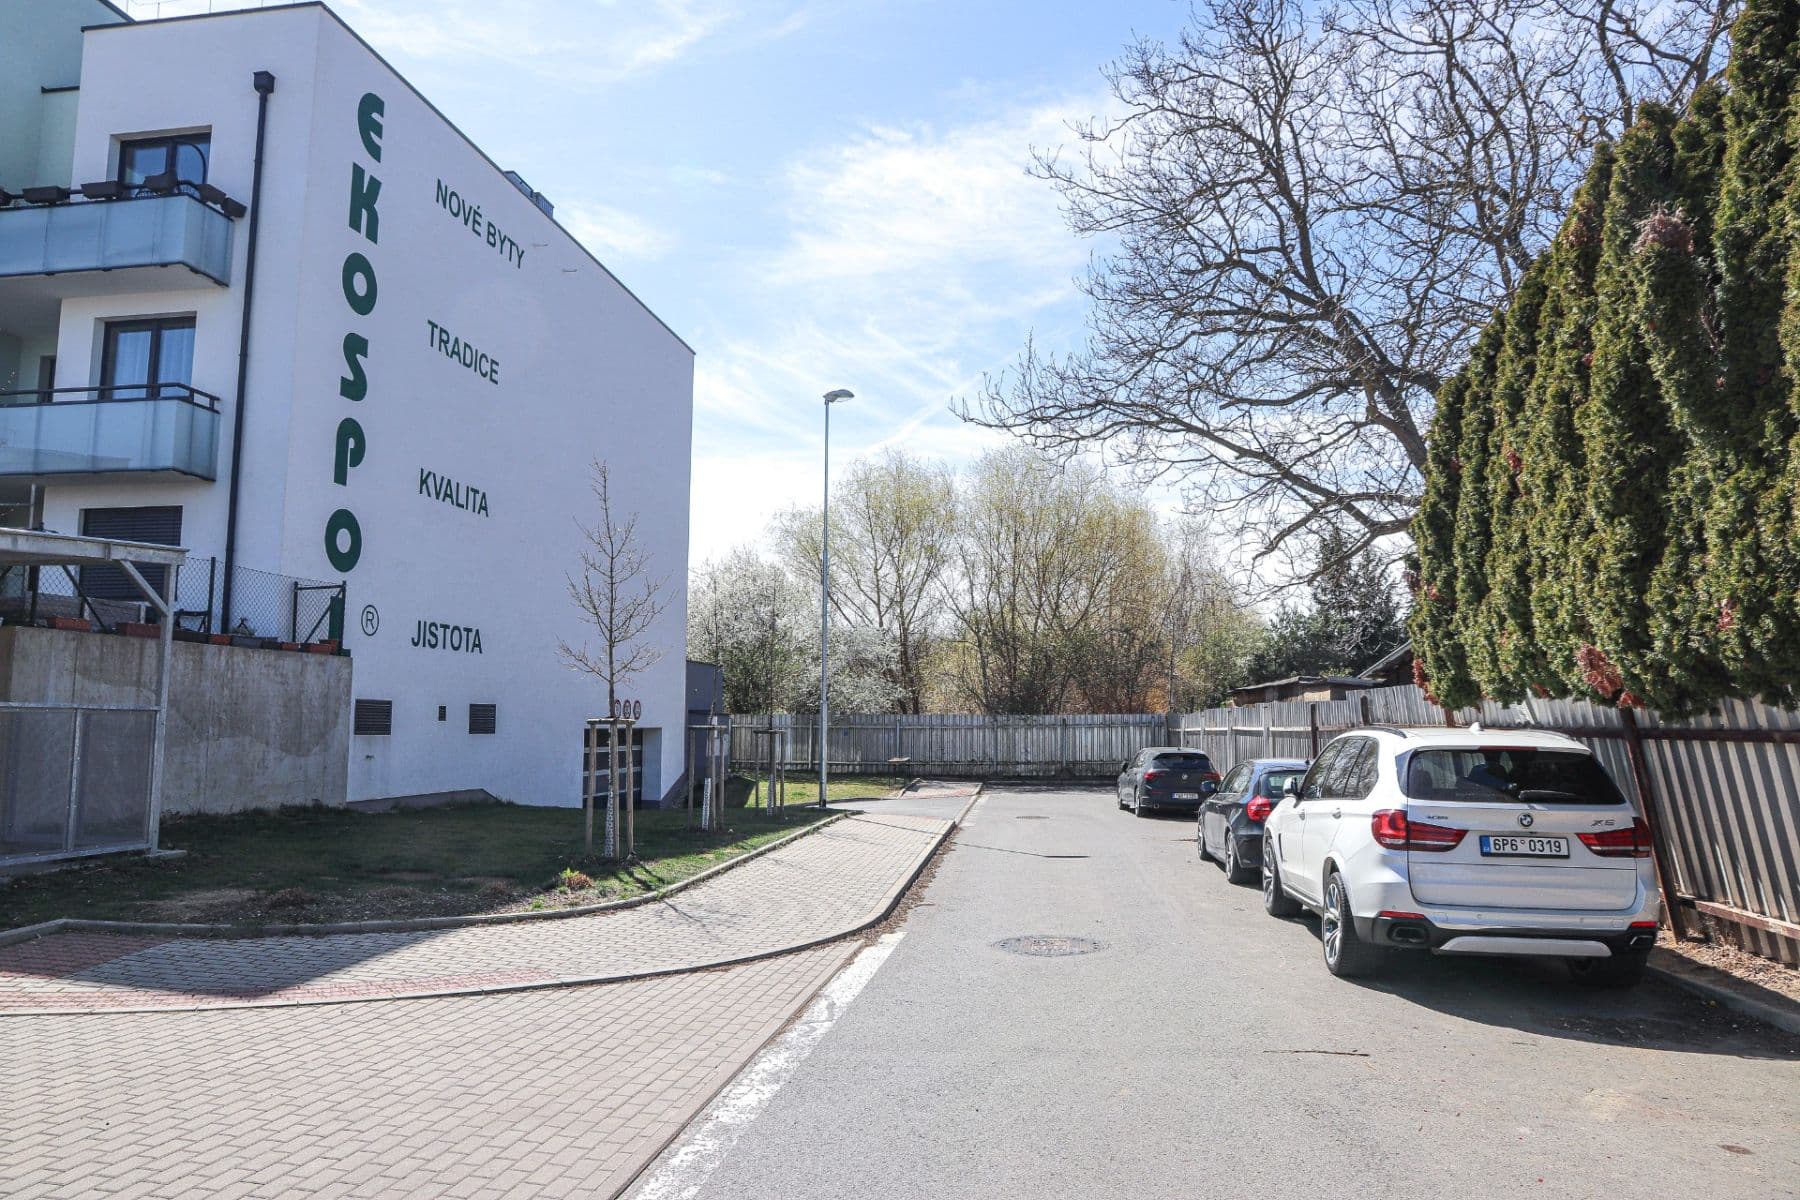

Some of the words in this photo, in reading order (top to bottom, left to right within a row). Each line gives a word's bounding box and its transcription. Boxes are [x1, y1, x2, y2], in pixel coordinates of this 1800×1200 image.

[436, 178, 482, 237] NOVÉ
[486, 221, 525, 269] BYTY
[427, 319, 500, 385] TRADICE
[419, 467, 489, 517] KVALITA
[411, 620, 483, 654] JISTOTA
[1590, 819, 1616, 827] X5
[1493, 838, 1519, 852] 6P6
[1528, 839, 1562, 853] 0319
